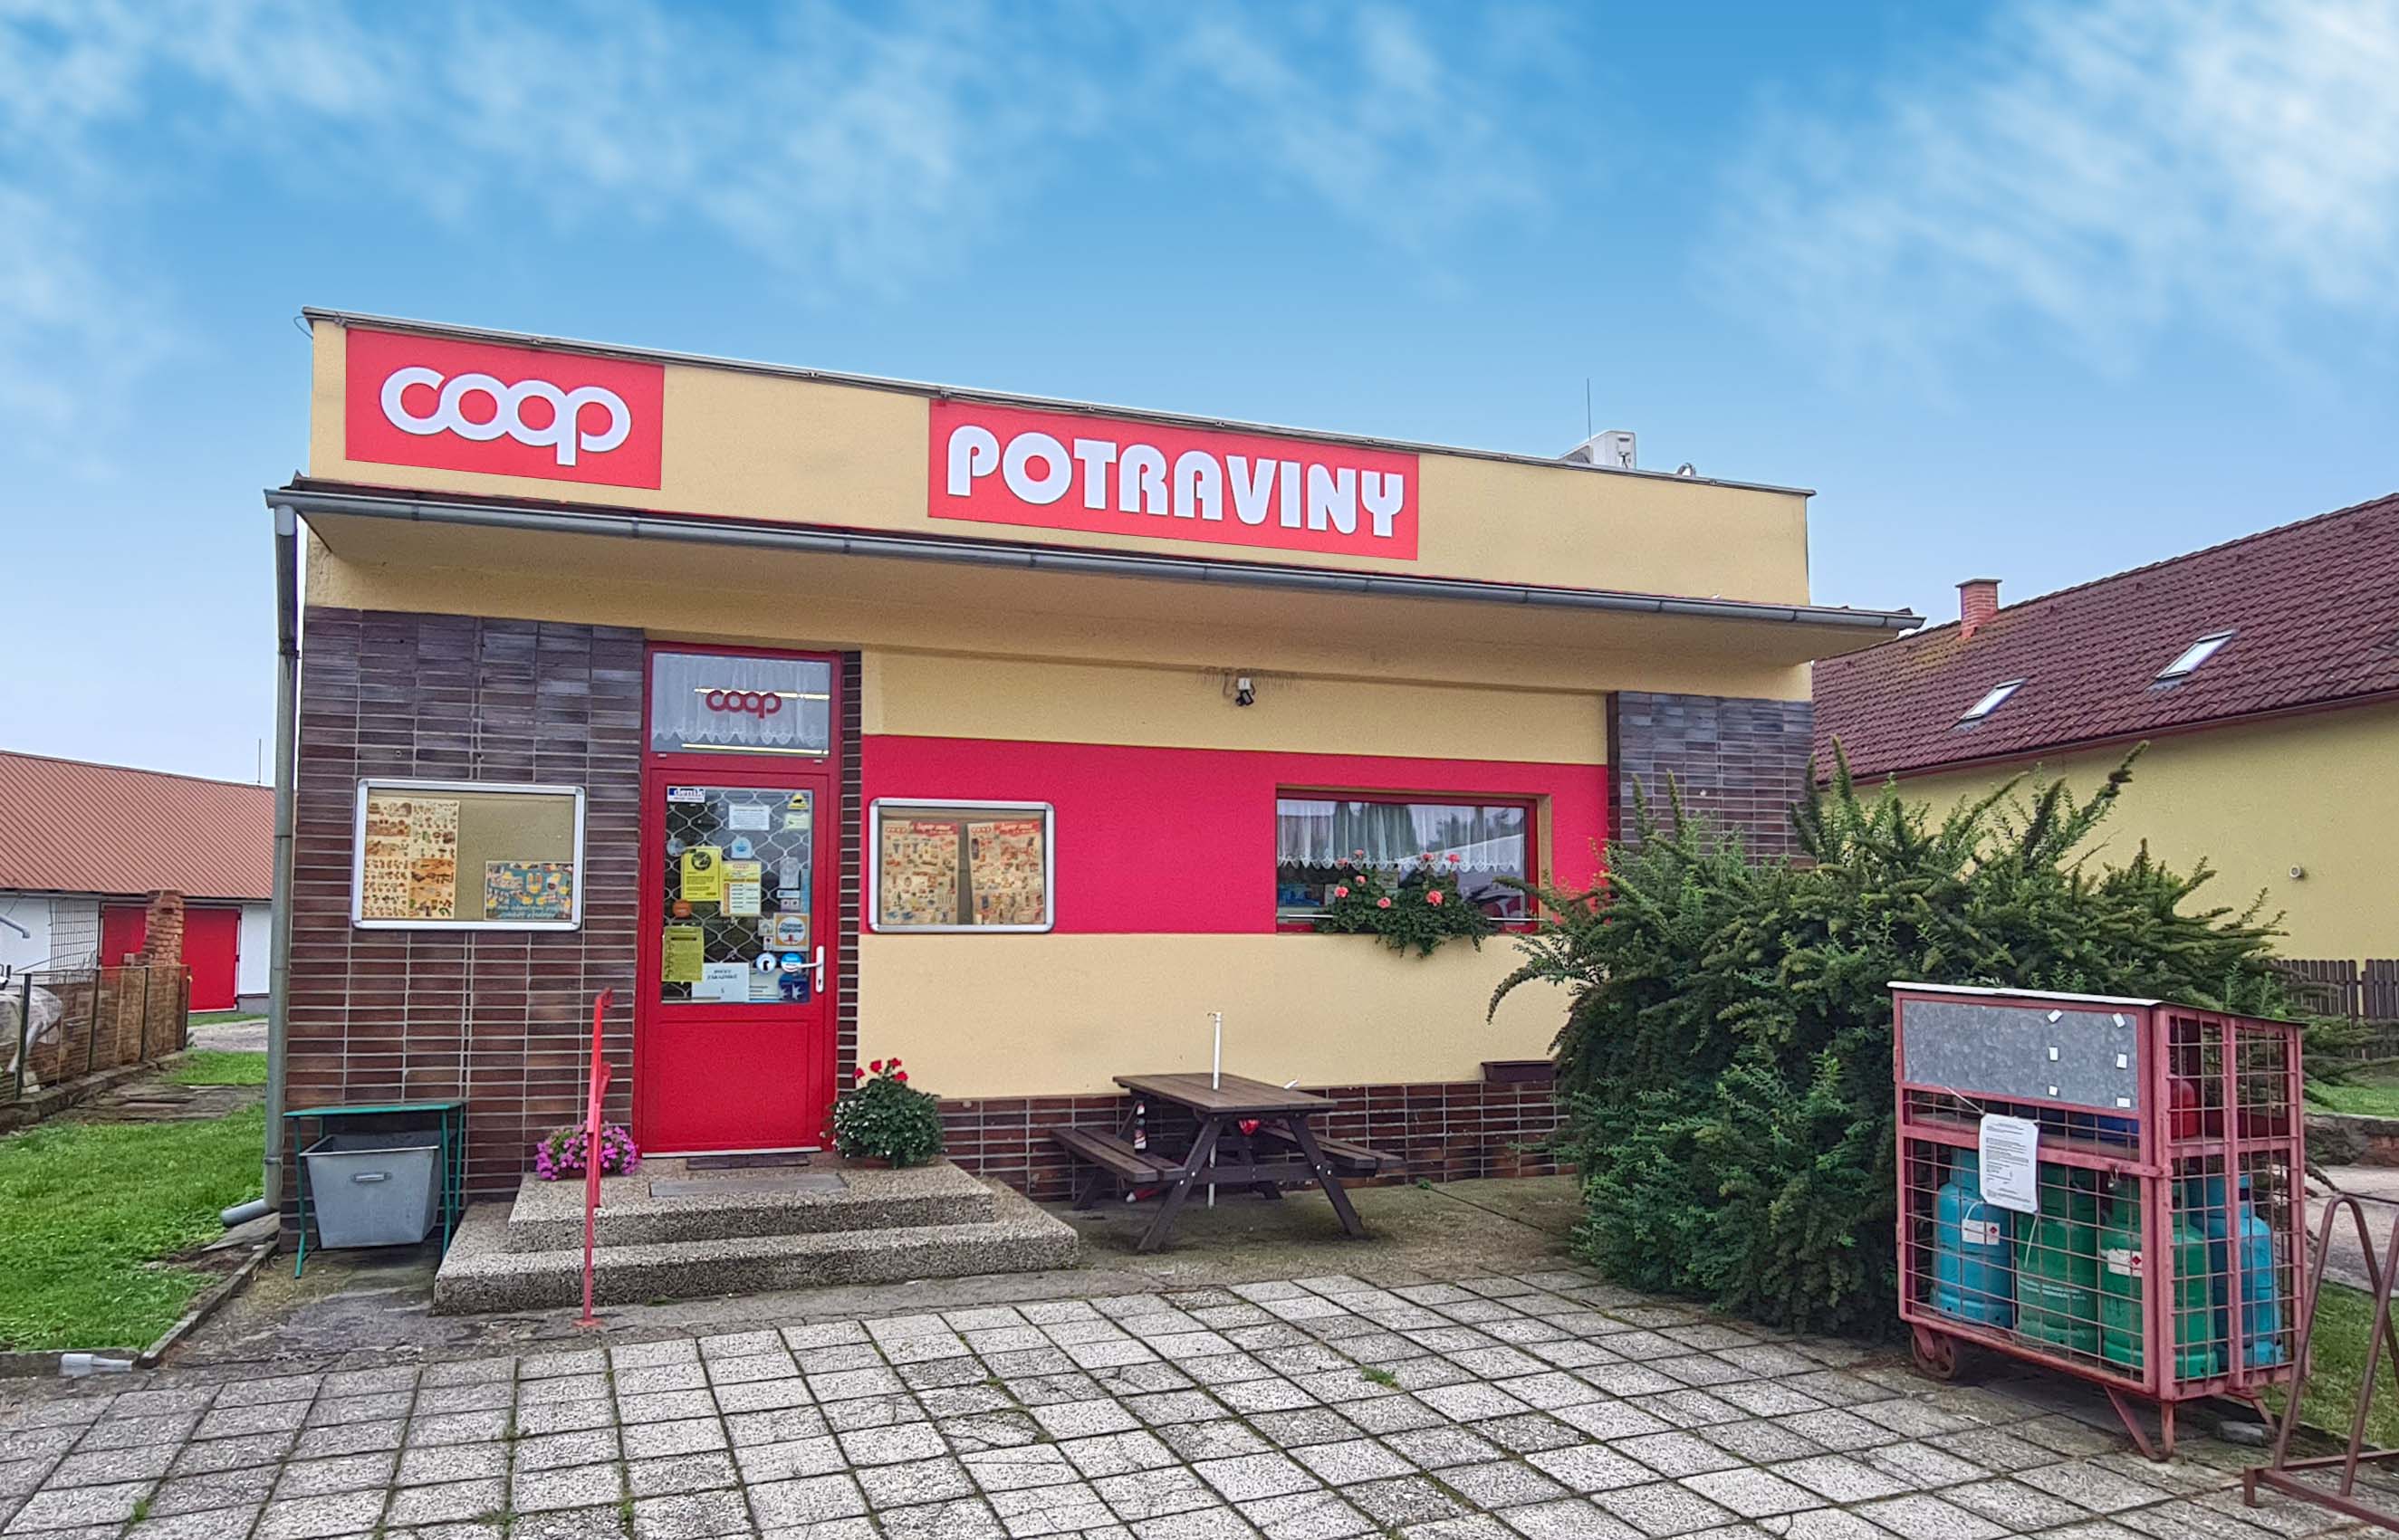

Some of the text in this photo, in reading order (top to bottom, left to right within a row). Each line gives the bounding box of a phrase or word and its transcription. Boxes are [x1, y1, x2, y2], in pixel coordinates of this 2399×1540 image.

[381, 367, 631, 467] coop
[947, 426, 1405, 538] POTRAVINY
[705, 690, 782, 720] coop
